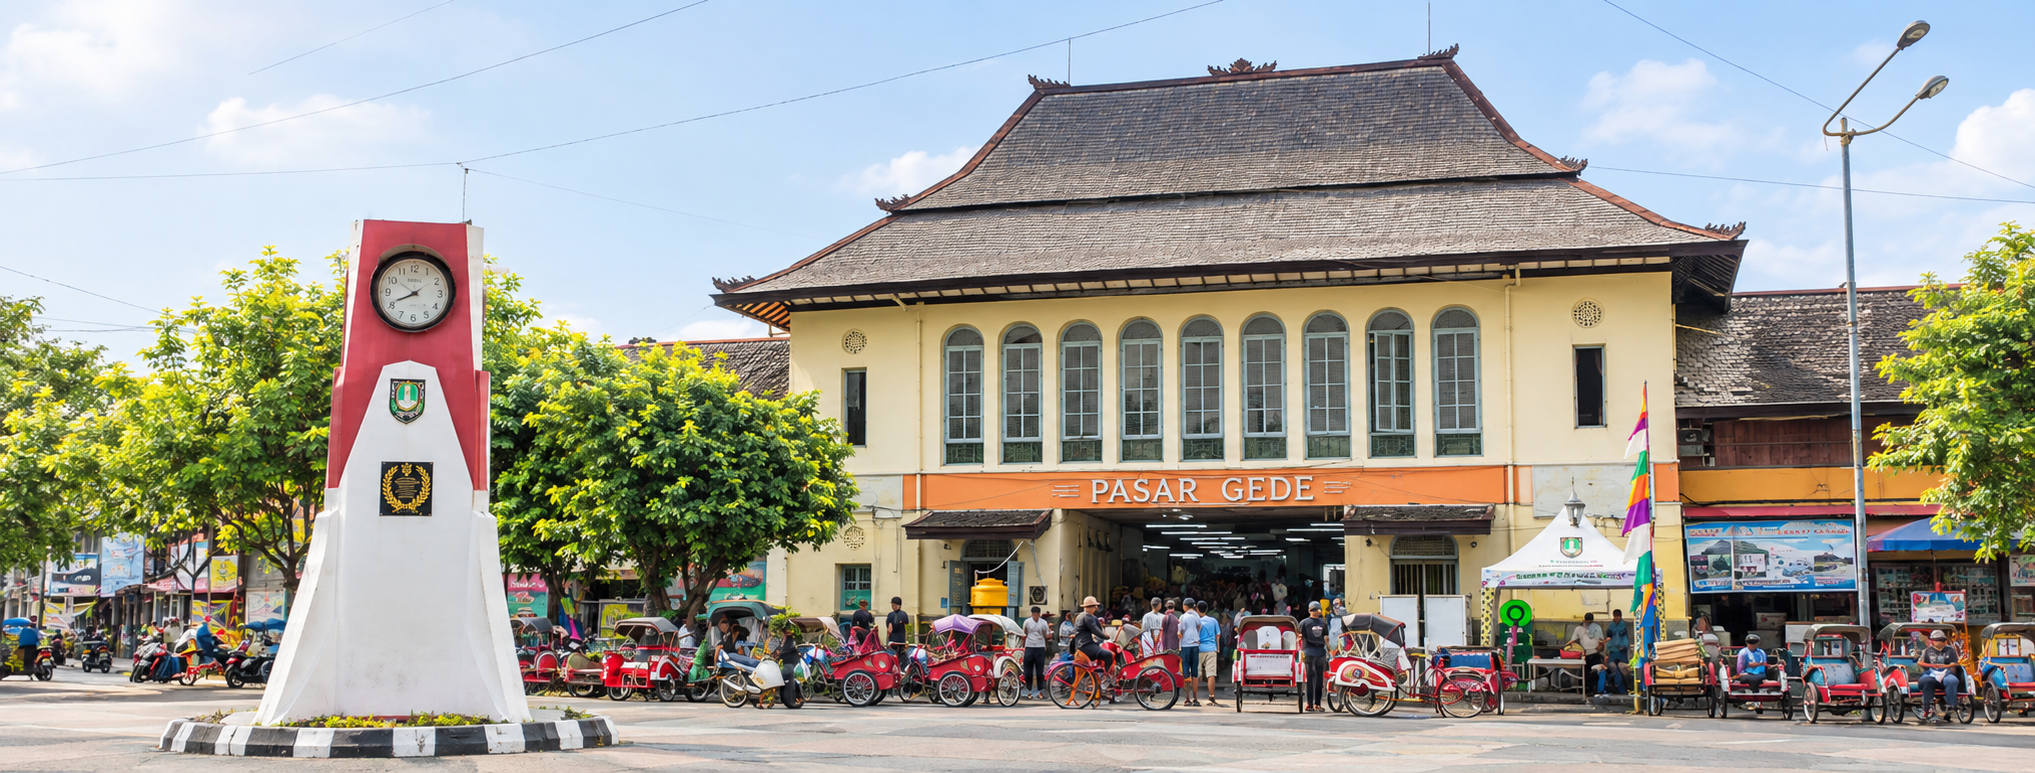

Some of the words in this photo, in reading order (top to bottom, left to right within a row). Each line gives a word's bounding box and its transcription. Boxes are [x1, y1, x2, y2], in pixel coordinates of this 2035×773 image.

[410, 265, 419, 273] 12
[388, 276, 397, 285] 10
[434, 277, 439, 285] 2
[385, 288, 391, 296] 9
[437, 290, 443, 298] 3
[389, 301, 395, 309] 8
[410, 314, 416, 322] 6
[423, 311, 429, 319] 5
[1091, 478, 1199, 503] PASAR
[1221, 476, 1315, 502] GEDE
